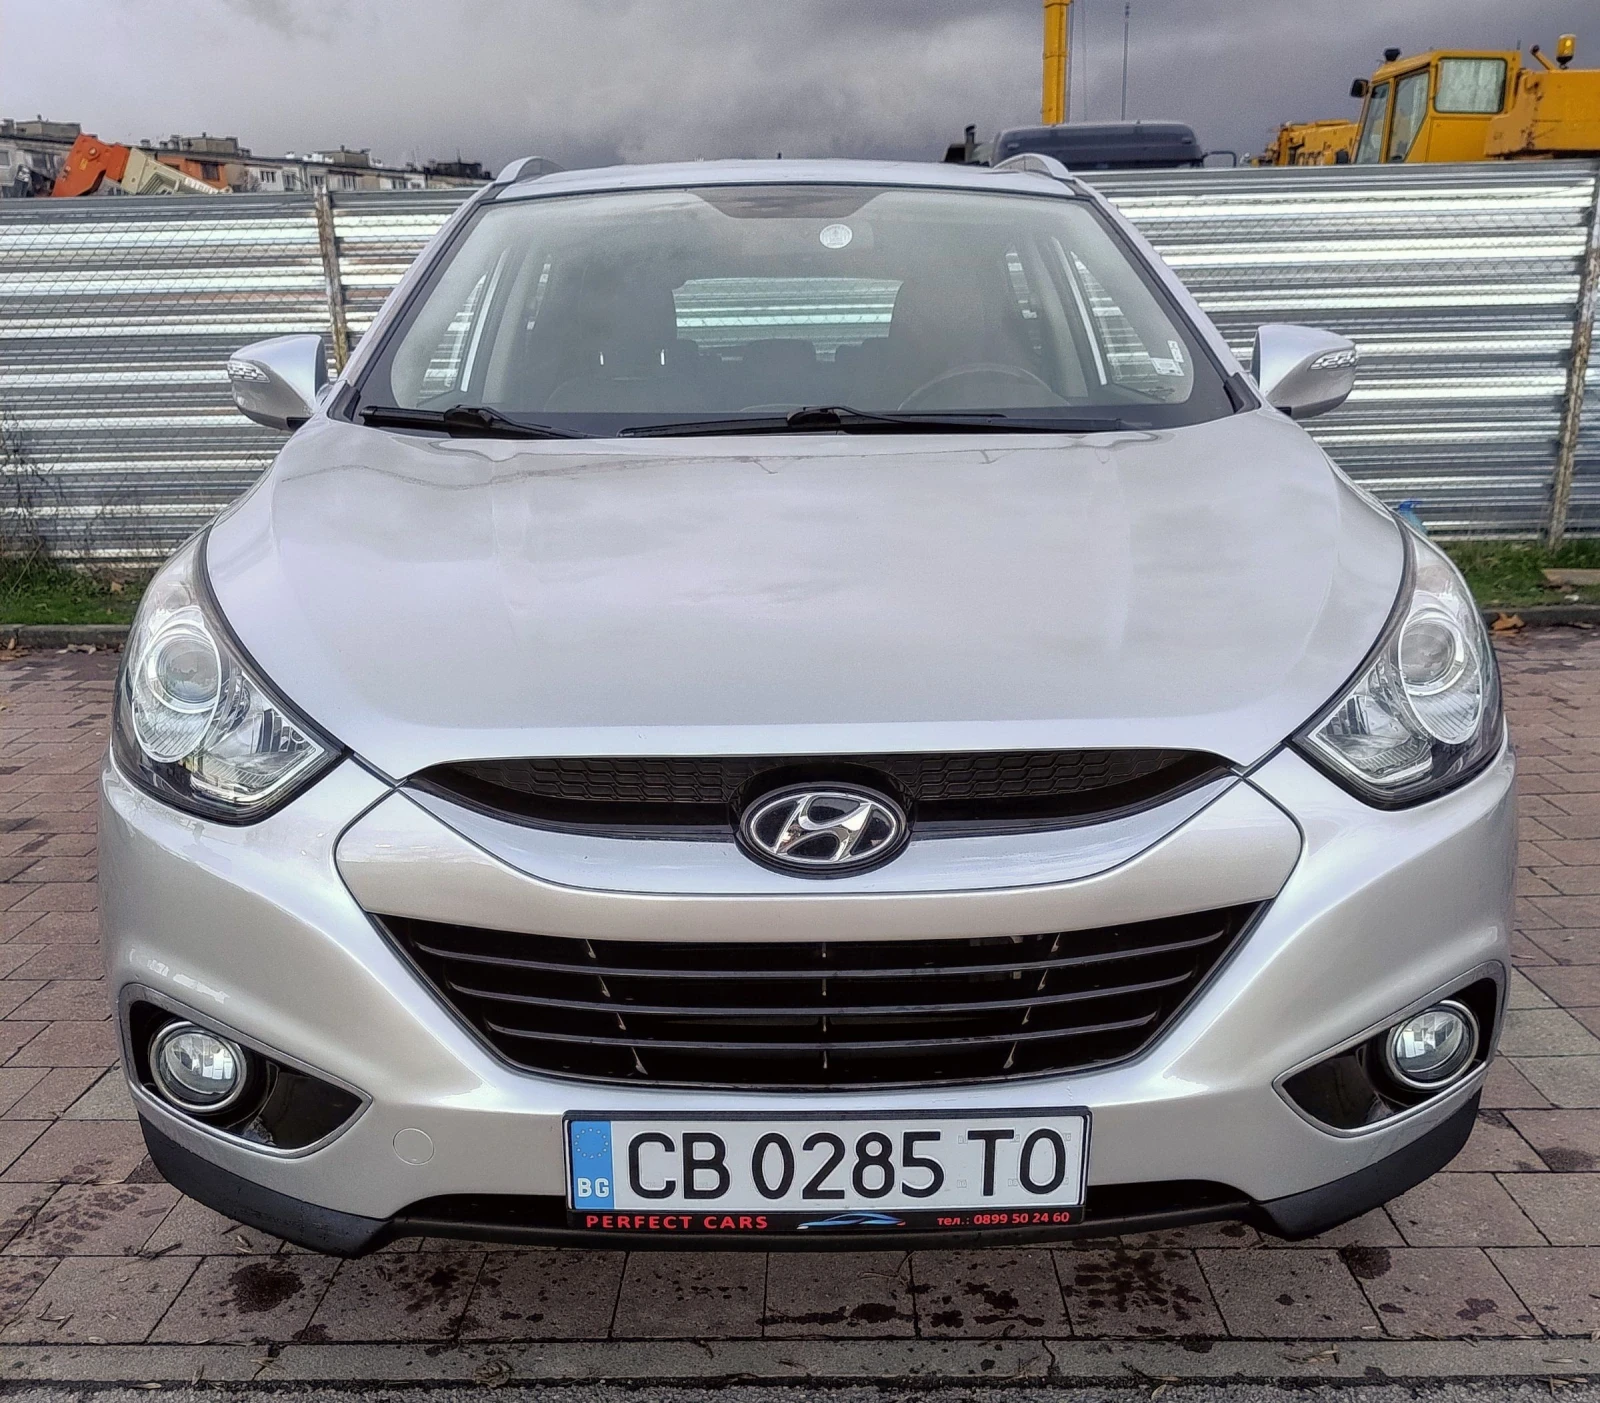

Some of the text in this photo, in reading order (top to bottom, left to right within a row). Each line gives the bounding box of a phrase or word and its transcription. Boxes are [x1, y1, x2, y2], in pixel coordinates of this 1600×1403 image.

[628, 1128, 1066, 1199] CB 0285 TO
[577, 1177, 610, 1198] BG
[586, 1215, 769, 1229] PERFECT CARS
[973, 1213, 1008, 1225] 0899
[1011, 1213, 1029, 1224] 50
[1032, 1212, 1050, 1223] 24
[1052, 1211, 1070, 1223] 60
